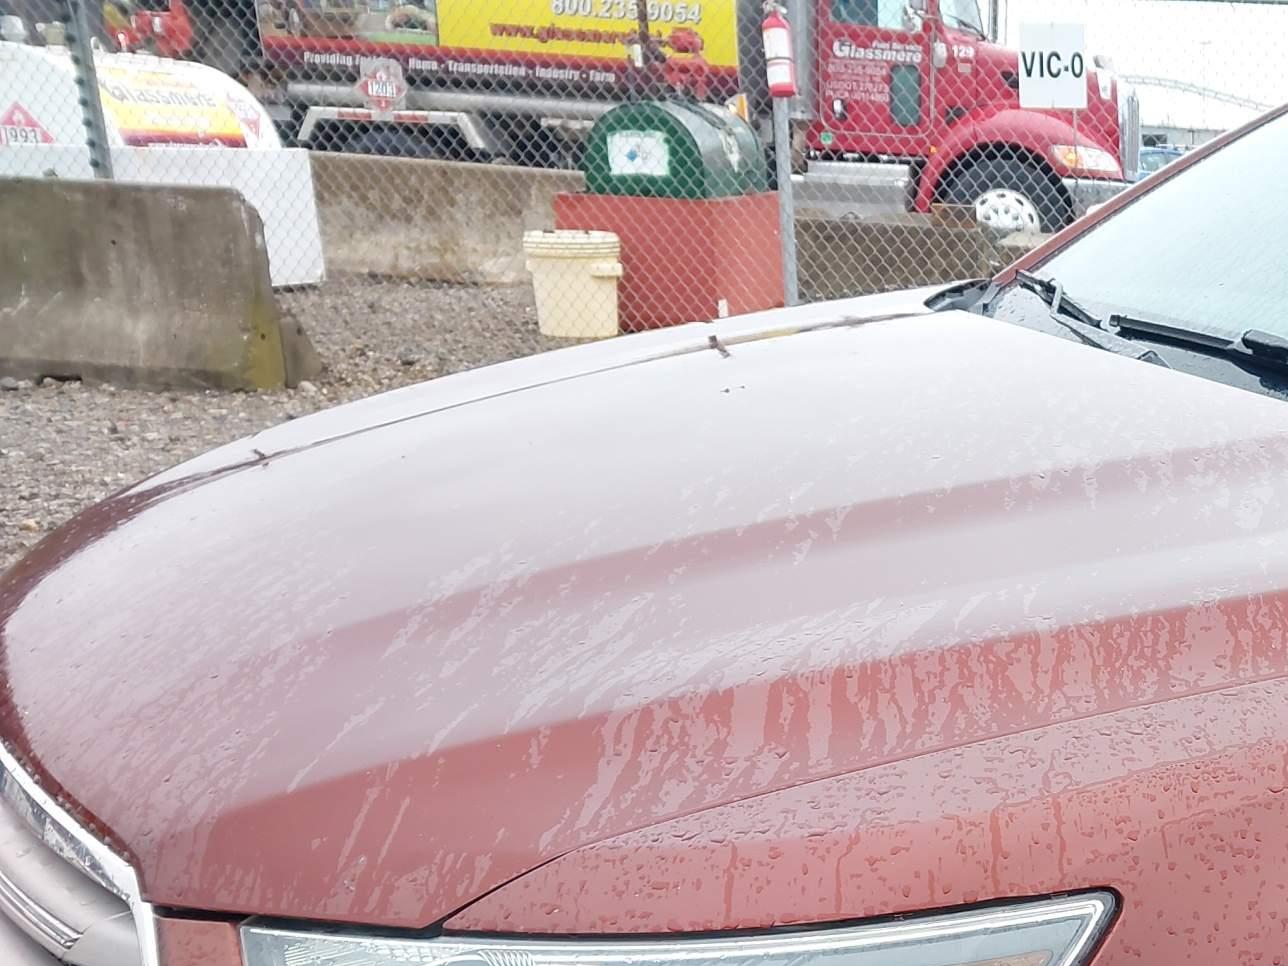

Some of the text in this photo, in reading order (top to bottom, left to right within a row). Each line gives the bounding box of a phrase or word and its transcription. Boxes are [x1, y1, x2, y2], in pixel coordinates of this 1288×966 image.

[832, 40, 922, 63] Glassmere
[952, 45, 975, 59] 129
[304, 52, 352, 66] Providing
